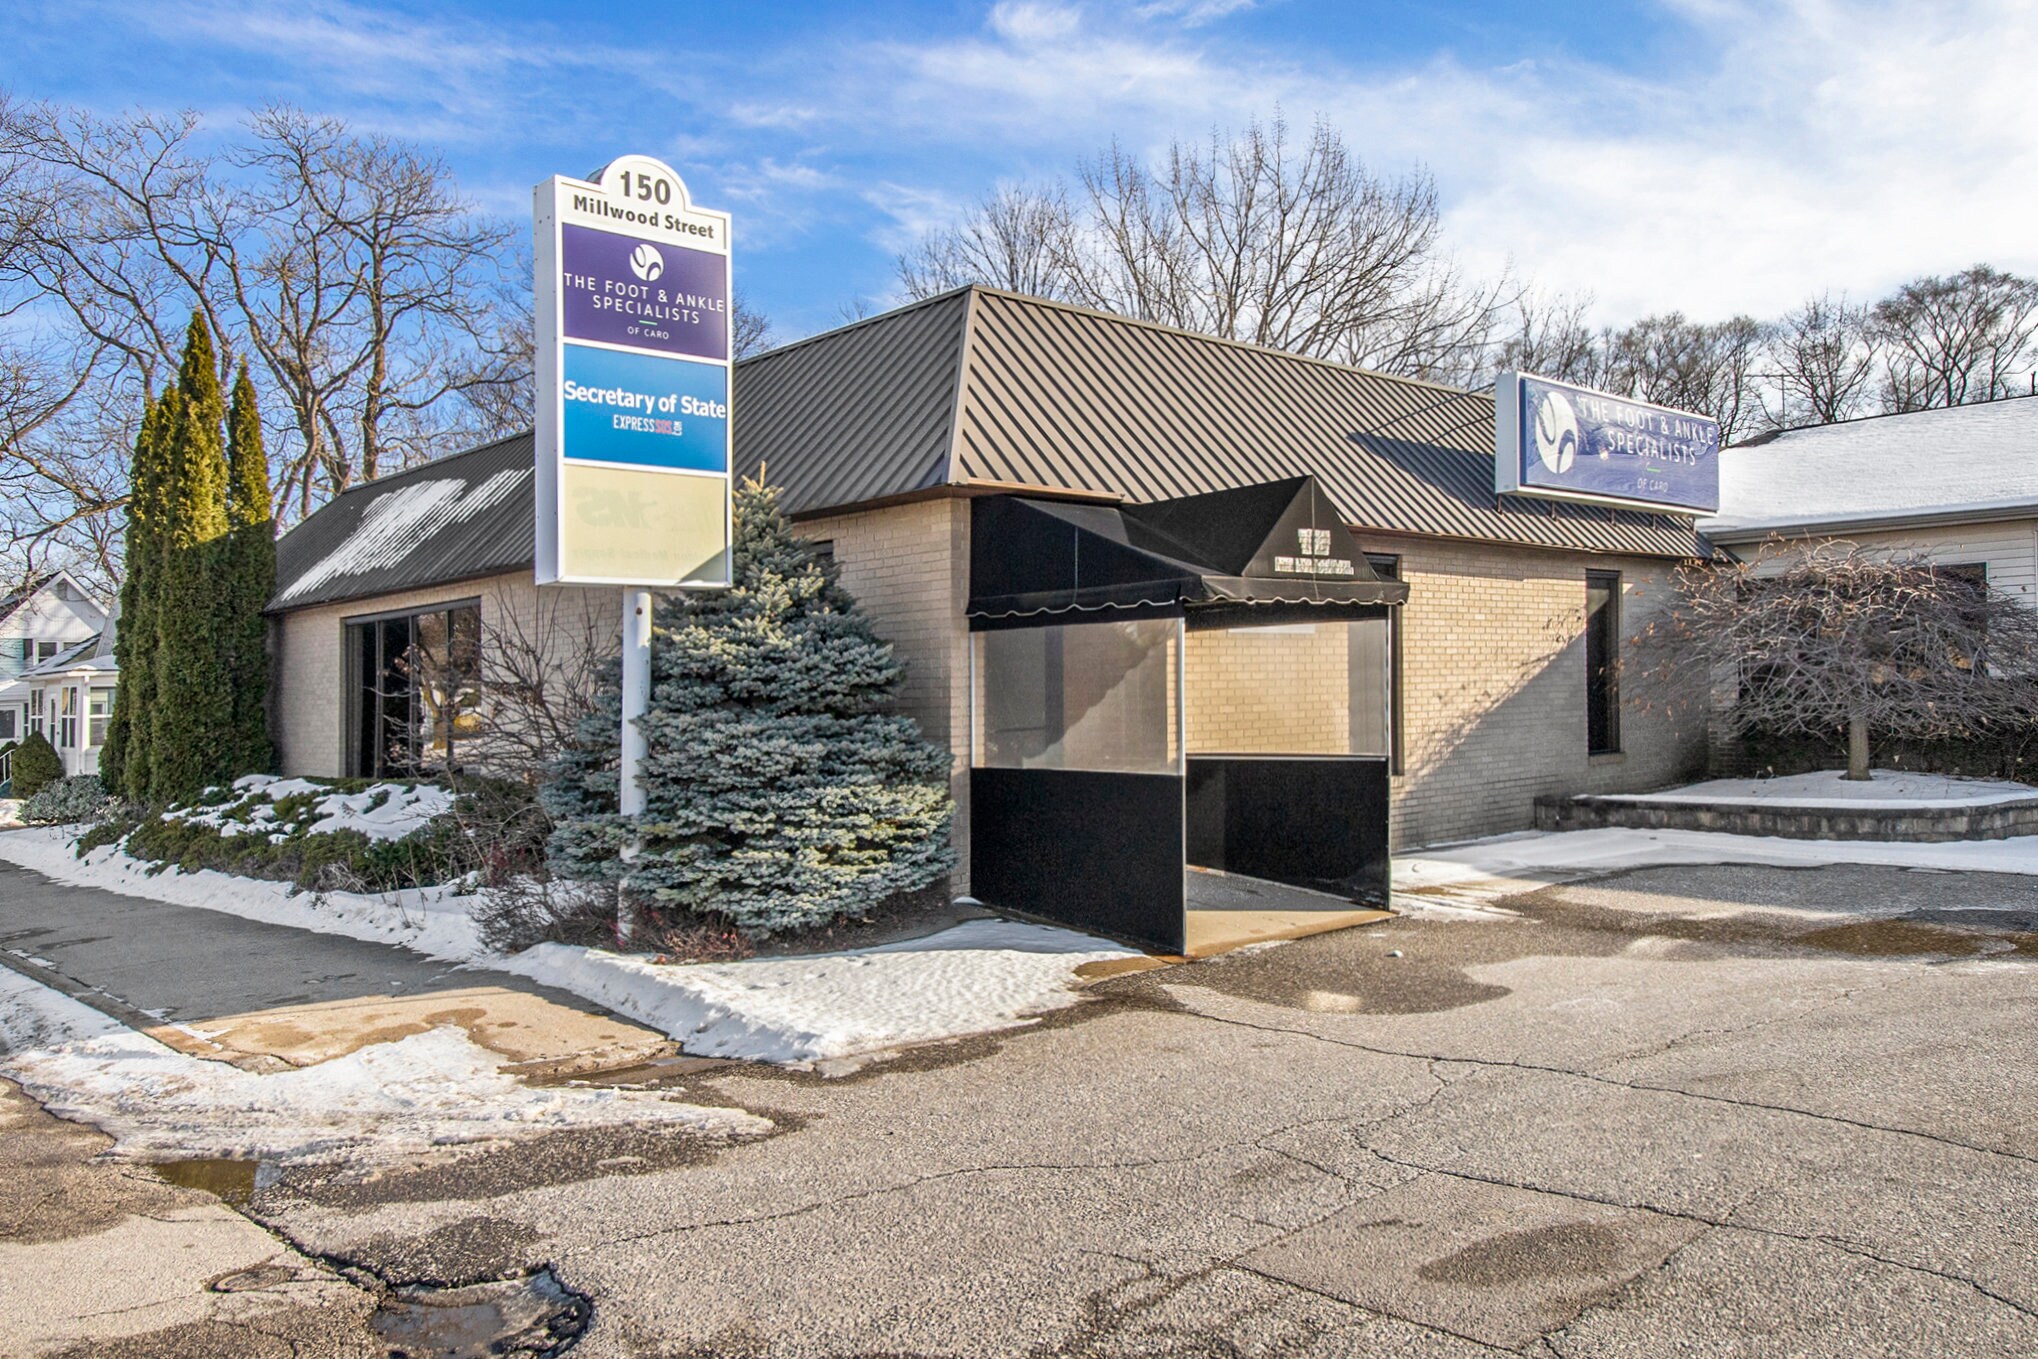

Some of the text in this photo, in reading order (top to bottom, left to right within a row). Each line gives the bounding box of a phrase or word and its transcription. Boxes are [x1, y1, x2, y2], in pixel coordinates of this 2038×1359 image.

[620, 170, 671, 205] 150
[574, 194, 715, 239] Millwood Street
[564, 272, 725, 312] THE FOOT & ANKLE
[593, 295, 700, 324] SPECIALISTS
[627, 326, 670, 340] OF CARO
[563, 380, 726, 419] Secretary of State
[1578, 395, 1714, 446] THE FOOT & ANKLE
[1607, 430, 1696, 466] SPECIALISTS
[1637, 477, 1648, 489] OF
